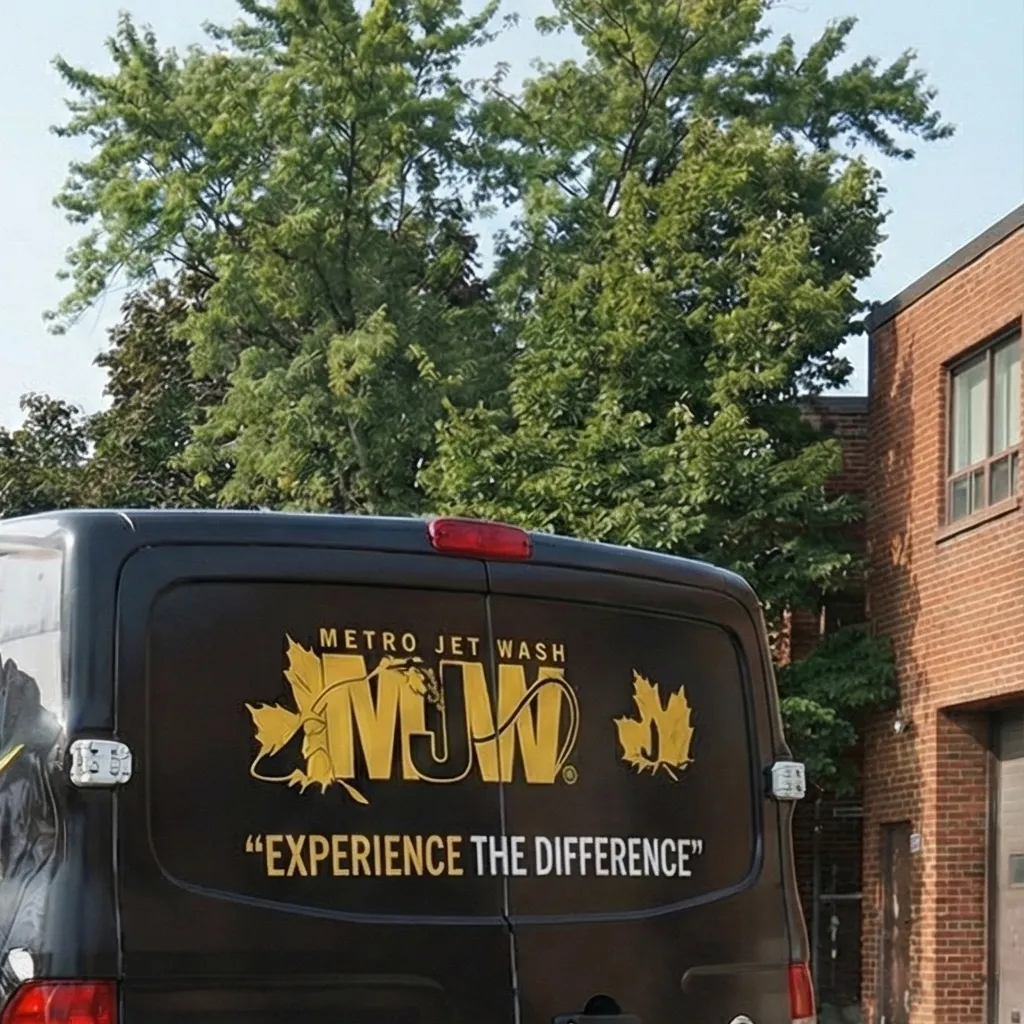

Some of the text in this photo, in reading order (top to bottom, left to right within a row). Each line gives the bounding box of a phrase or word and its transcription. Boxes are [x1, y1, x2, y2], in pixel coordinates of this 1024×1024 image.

[319, 628, 565, 662] METRO JET WASH
[245, 834, 703, 877] “EXPERIENCE THE DIFFERENCE”
